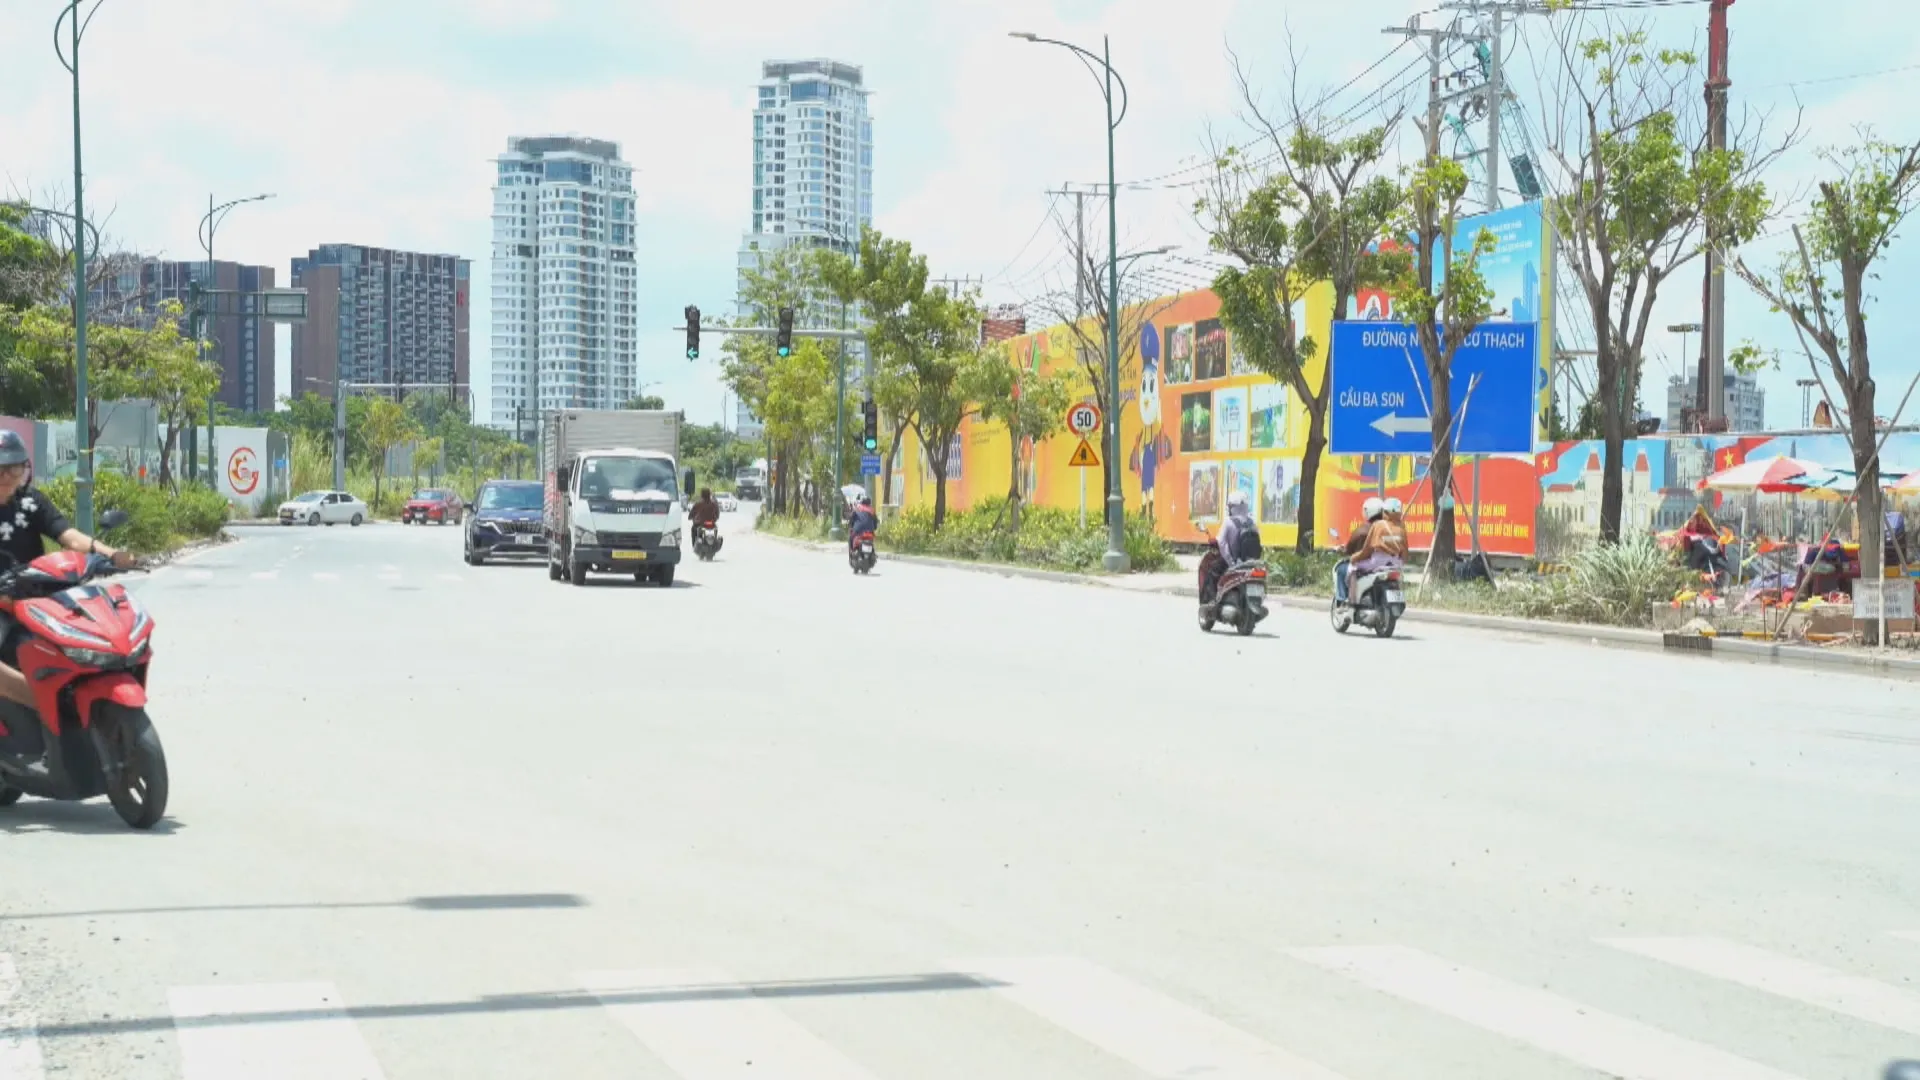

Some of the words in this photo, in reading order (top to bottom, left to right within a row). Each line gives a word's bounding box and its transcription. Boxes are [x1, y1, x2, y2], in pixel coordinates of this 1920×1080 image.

[1362, 327, 1407, 347] ĐƯỜNG
[1483, 332, 1525, 352] THẠCH
[1363, 391, 1378, 407] BA
[1381, 391, 1404, 408] SON
[1077, 411, 1092, 427] 50
